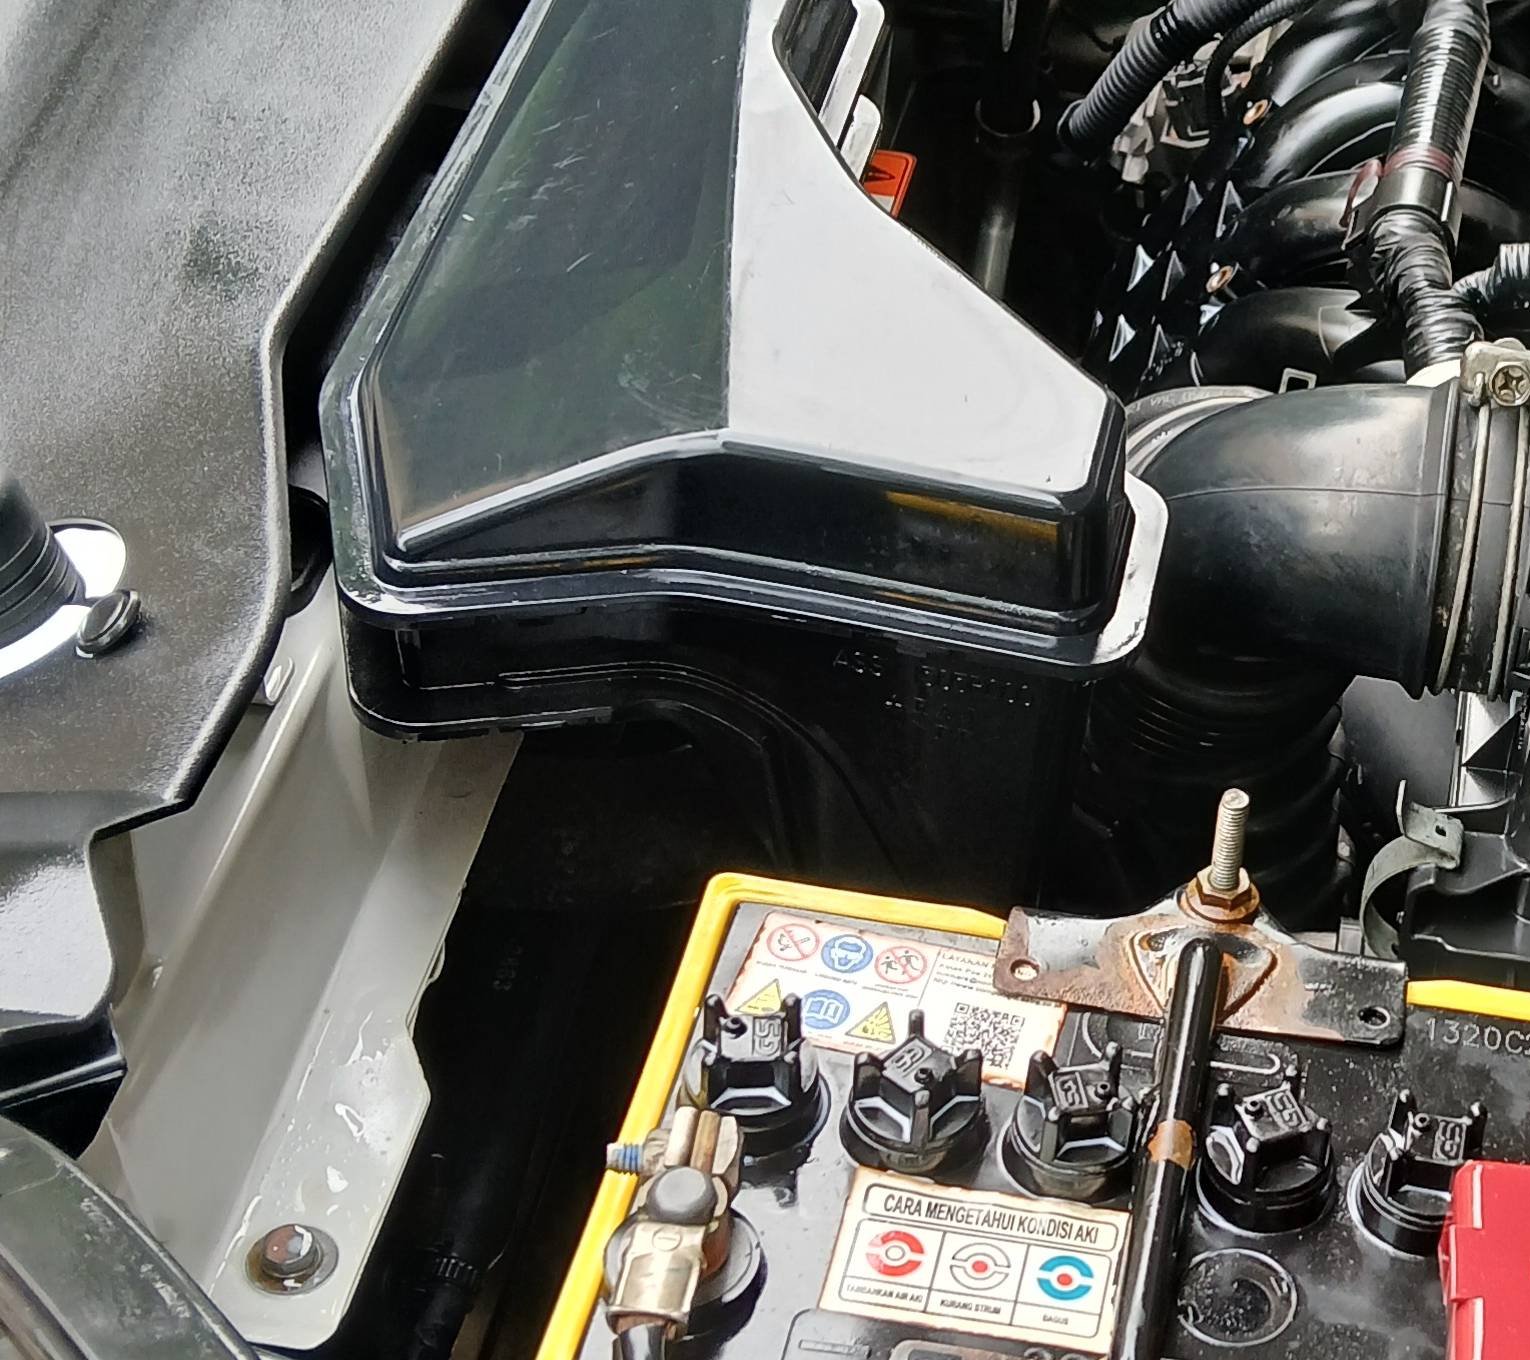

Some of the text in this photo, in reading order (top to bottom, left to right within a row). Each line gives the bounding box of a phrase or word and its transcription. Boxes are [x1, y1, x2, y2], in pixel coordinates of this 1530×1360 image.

[883, 1194, 1099, 1244] CARA MENGETAHUI KONDISI AKI
